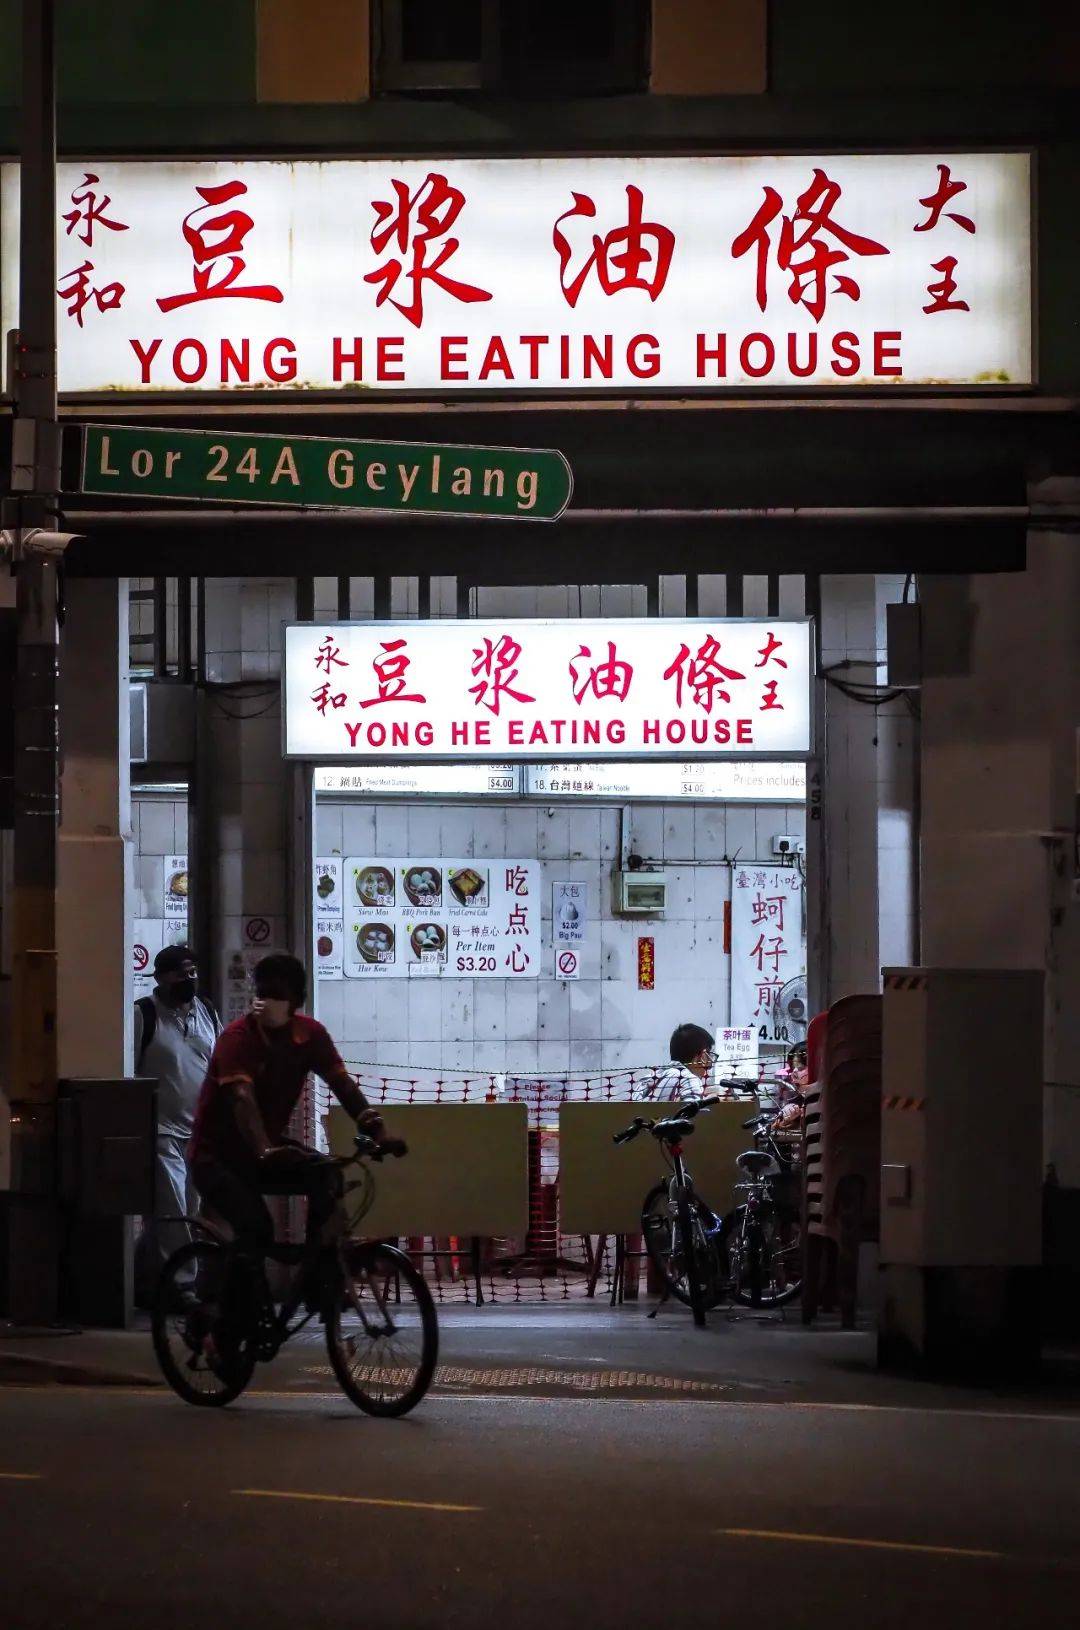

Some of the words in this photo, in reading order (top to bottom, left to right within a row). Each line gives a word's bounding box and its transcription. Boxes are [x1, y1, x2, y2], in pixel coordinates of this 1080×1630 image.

[57, 173, 130, 328] 永和
[156, 169, 890, 327] 豆漿油條
[912, 165, 976, 314] 大王
[129, 337, 298, 384] YONG
[332, 336, 405, 381] HE
[441, 335, 660, 380] EATING
[696, 331, 903, 375] HOUSE
[101, 436, 182, 478] Lor
[206, 444, 301, 486] 24A
[327, 449, 540, 509] Geylang
[310, 636, 350, 717] 永和
[359, 634, 747, 717] 豆漿油條
[754, 632, 788, 711] 大王
[345, 721, 434, 747] YONG
[451, 720, 491, 746] HE
[508, 719, 626, 745] EATING
[642, 718, 753, 745] HOUSE
[490, 778, 512, 788] $4.00
[504, 865, 530, 973] 吃点心
[560, 885, 580, 898] 大包
[456, 941, 472, 952] Per
[474, 941, 496, 952] Item
[456, 956, 497, 972] $3.20
[722, 1029, 752, 1041] 茶叶蛋
[747, 1022, 789, 1041] 4.00
